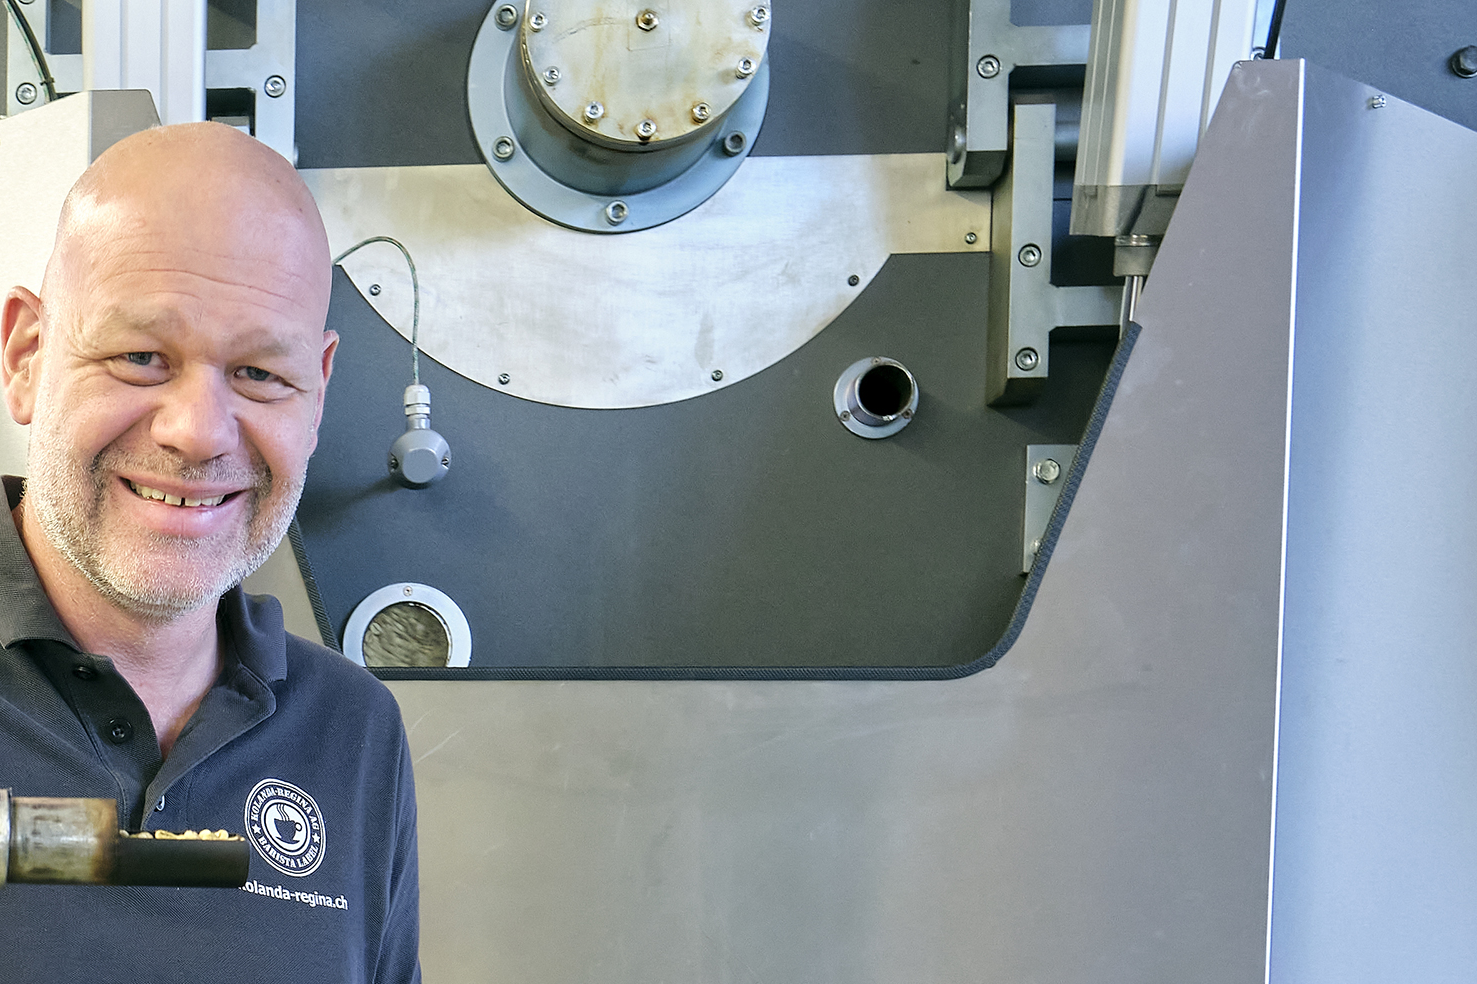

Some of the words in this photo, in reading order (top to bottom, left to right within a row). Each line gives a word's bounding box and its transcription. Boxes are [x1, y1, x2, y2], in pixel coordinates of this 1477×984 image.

[309, 814, 320, 831] AG
[258, 835, 297, 868] BARISTA
[296, 845, 319, 868] LABEL
[238, 879, 349, 911] olanda-regina.ch
